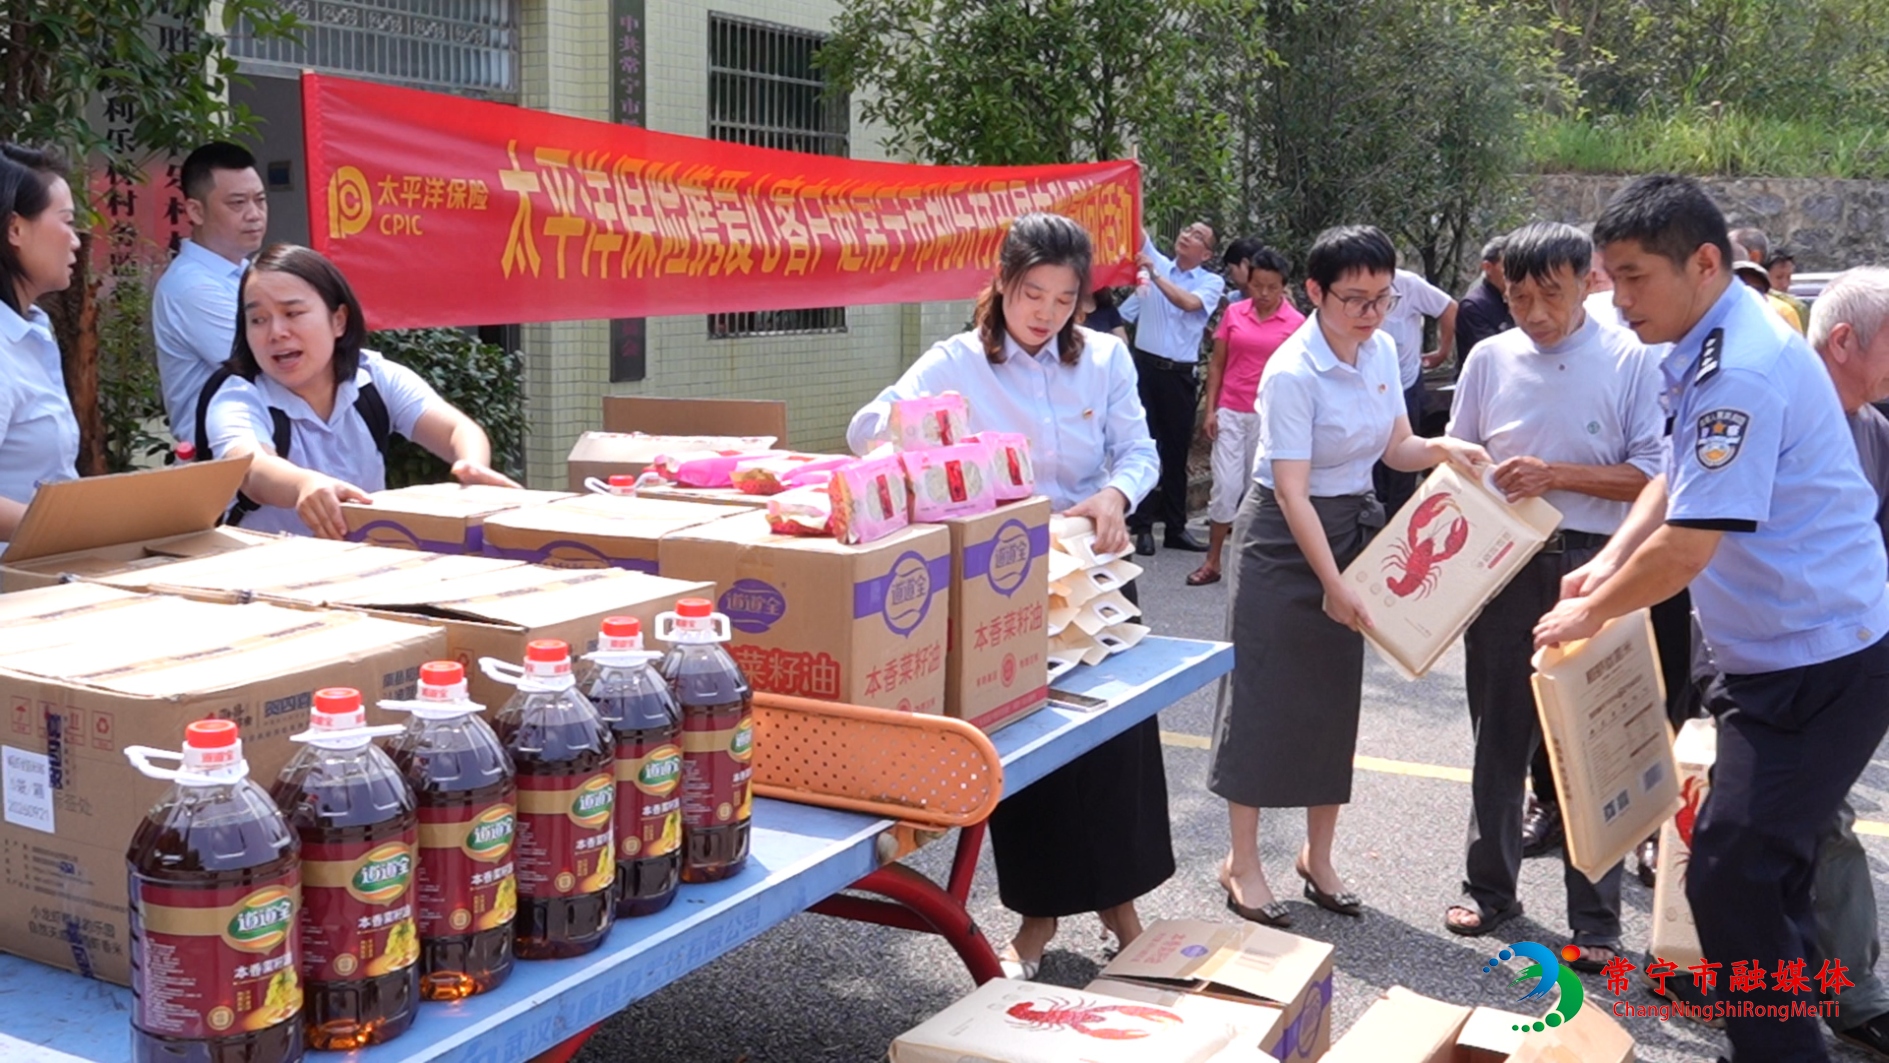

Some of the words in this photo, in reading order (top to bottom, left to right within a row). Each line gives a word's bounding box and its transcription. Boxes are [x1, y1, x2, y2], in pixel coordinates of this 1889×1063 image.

[377, 174, 489, 210] 太平洋保险
[379, 214, 424, 236] CPIC
[973, 601, 1044, 652] 本香菜籽油
[863, 641, 942, 699] 本香菜籽油
